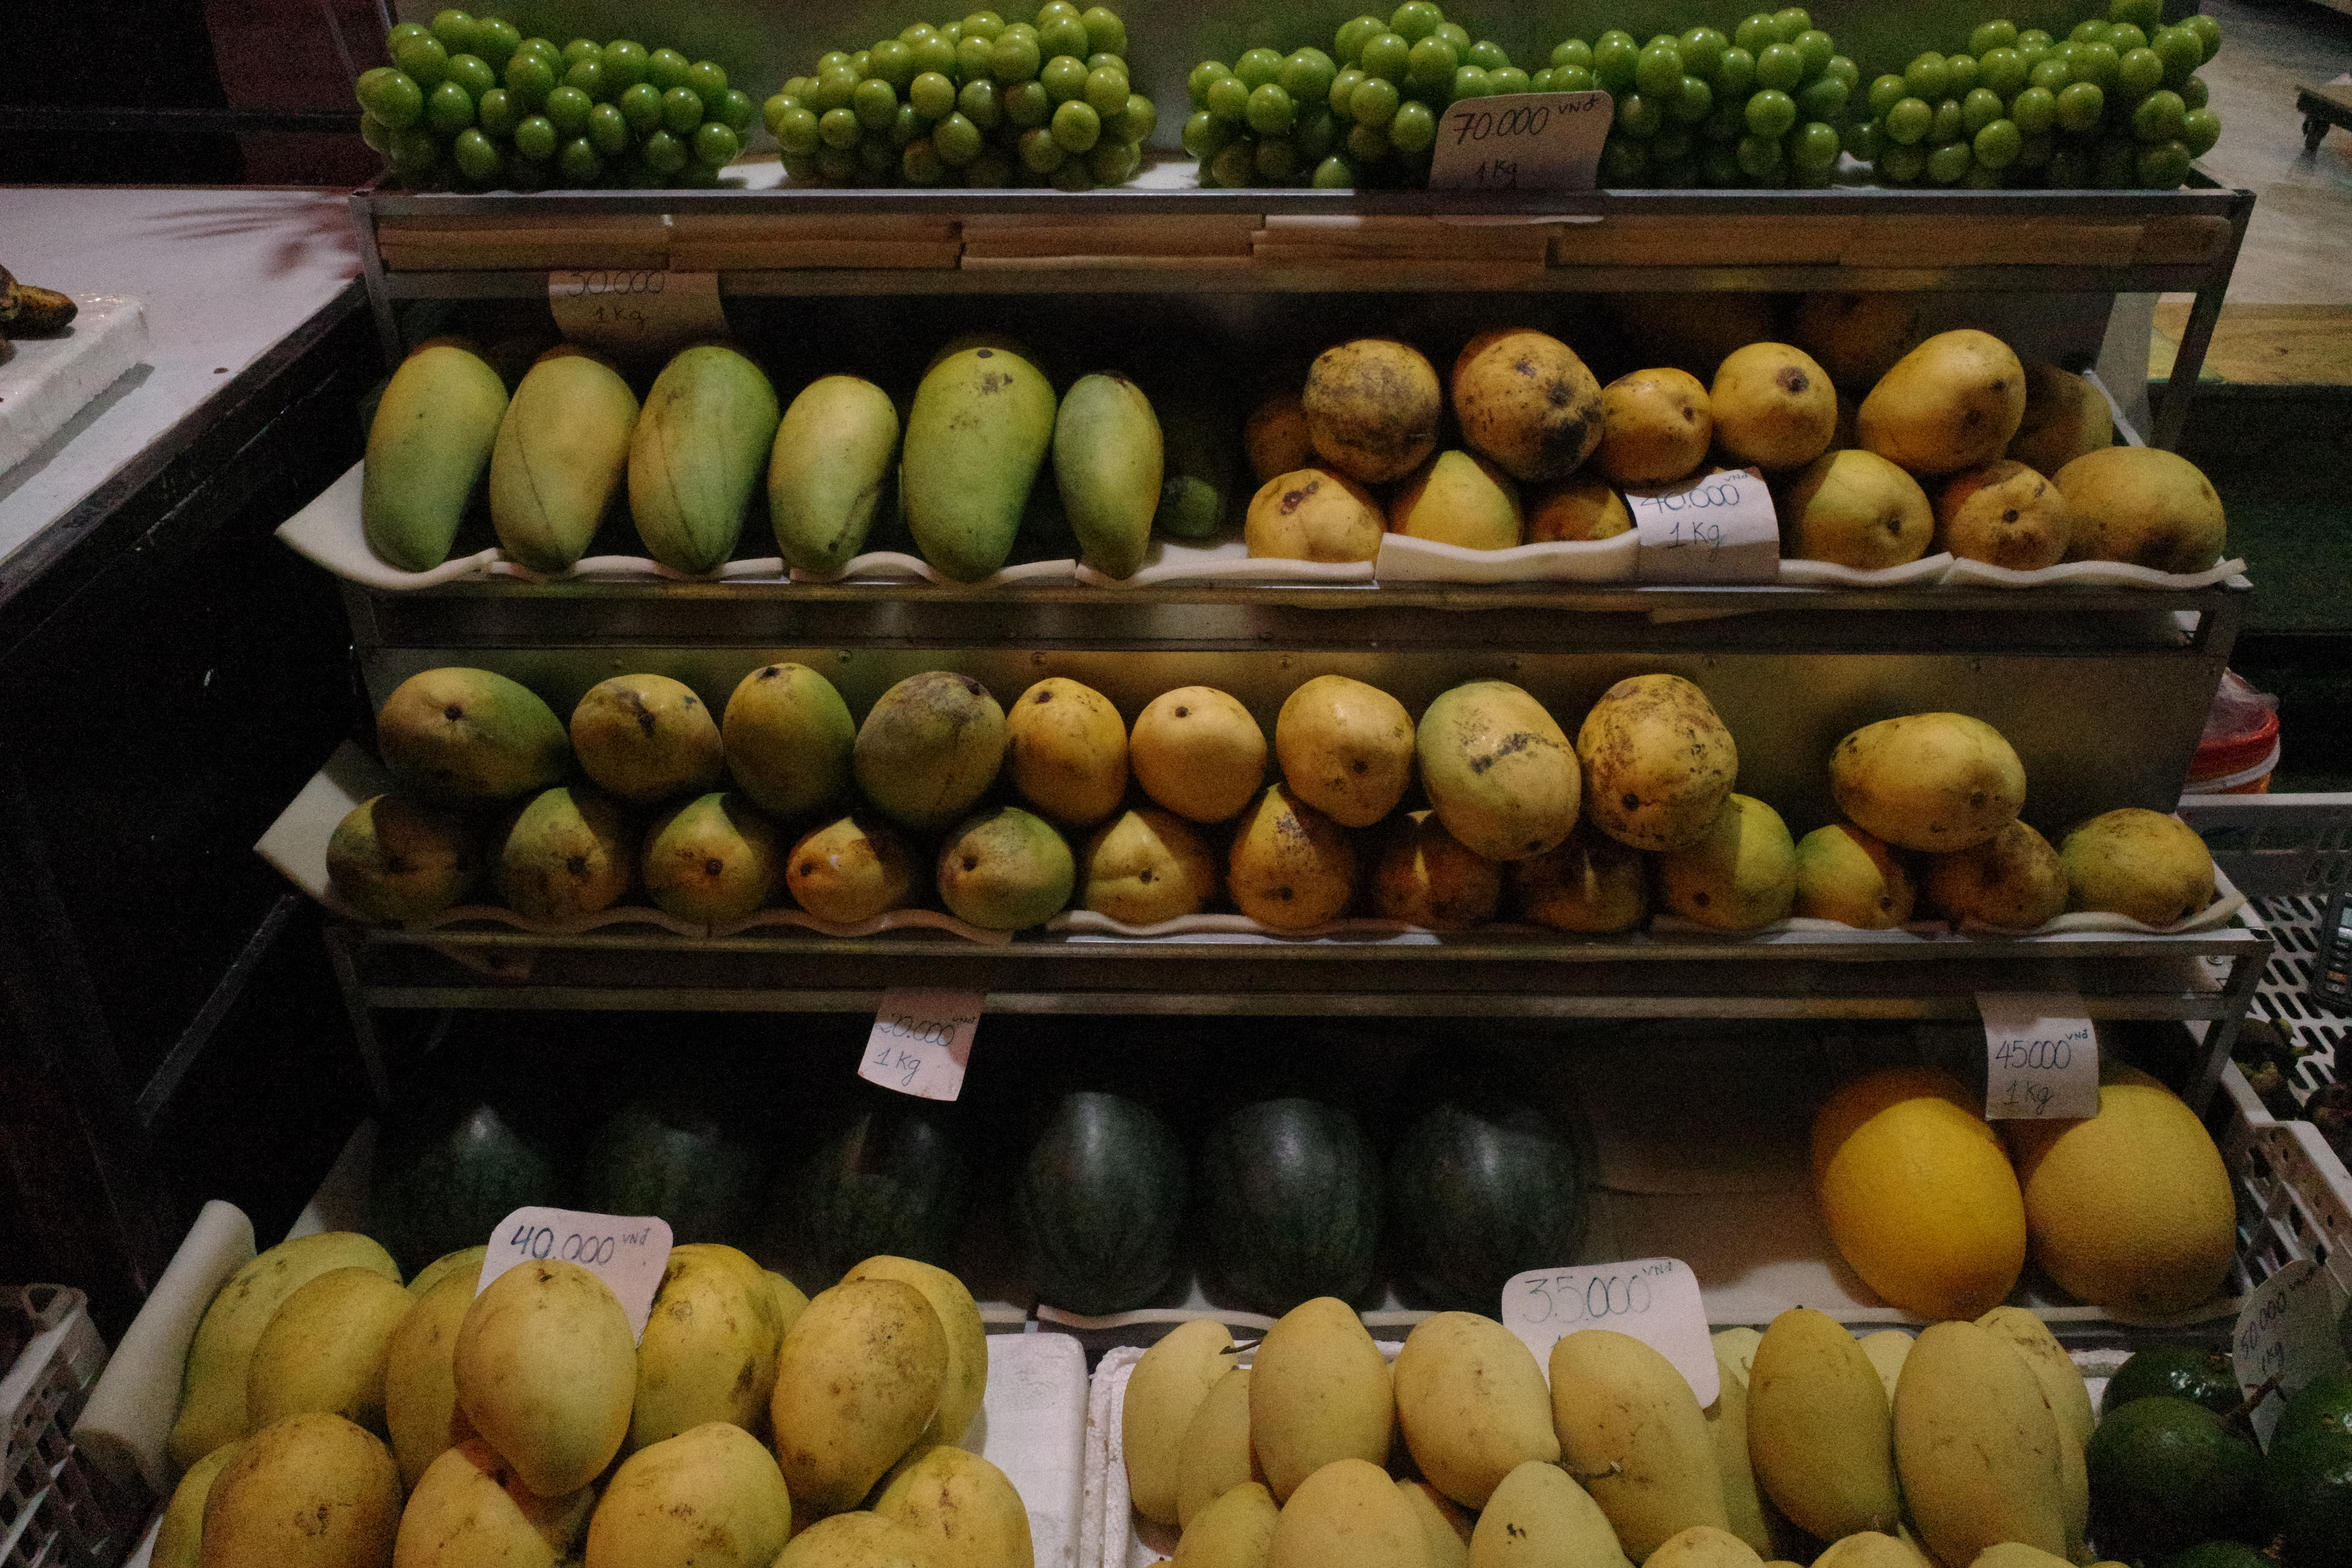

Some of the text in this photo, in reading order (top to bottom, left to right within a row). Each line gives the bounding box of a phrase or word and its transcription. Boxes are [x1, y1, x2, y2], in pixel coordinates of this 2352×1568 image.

[1476, 161, 1486, 184] 1
[593, 307, 610, 323] 1
[1641, 484, 1740, 514] 40.000
[1667, 521, 1725, 563] 1 Kg
[875, 1014, 955, 1046] 20.000
[873, 1048, 921, 1087] 1 Kg
[2003, 1080, 2054, 1115] 1 Kg
[510, 1225, 615, 1265] 40.000
